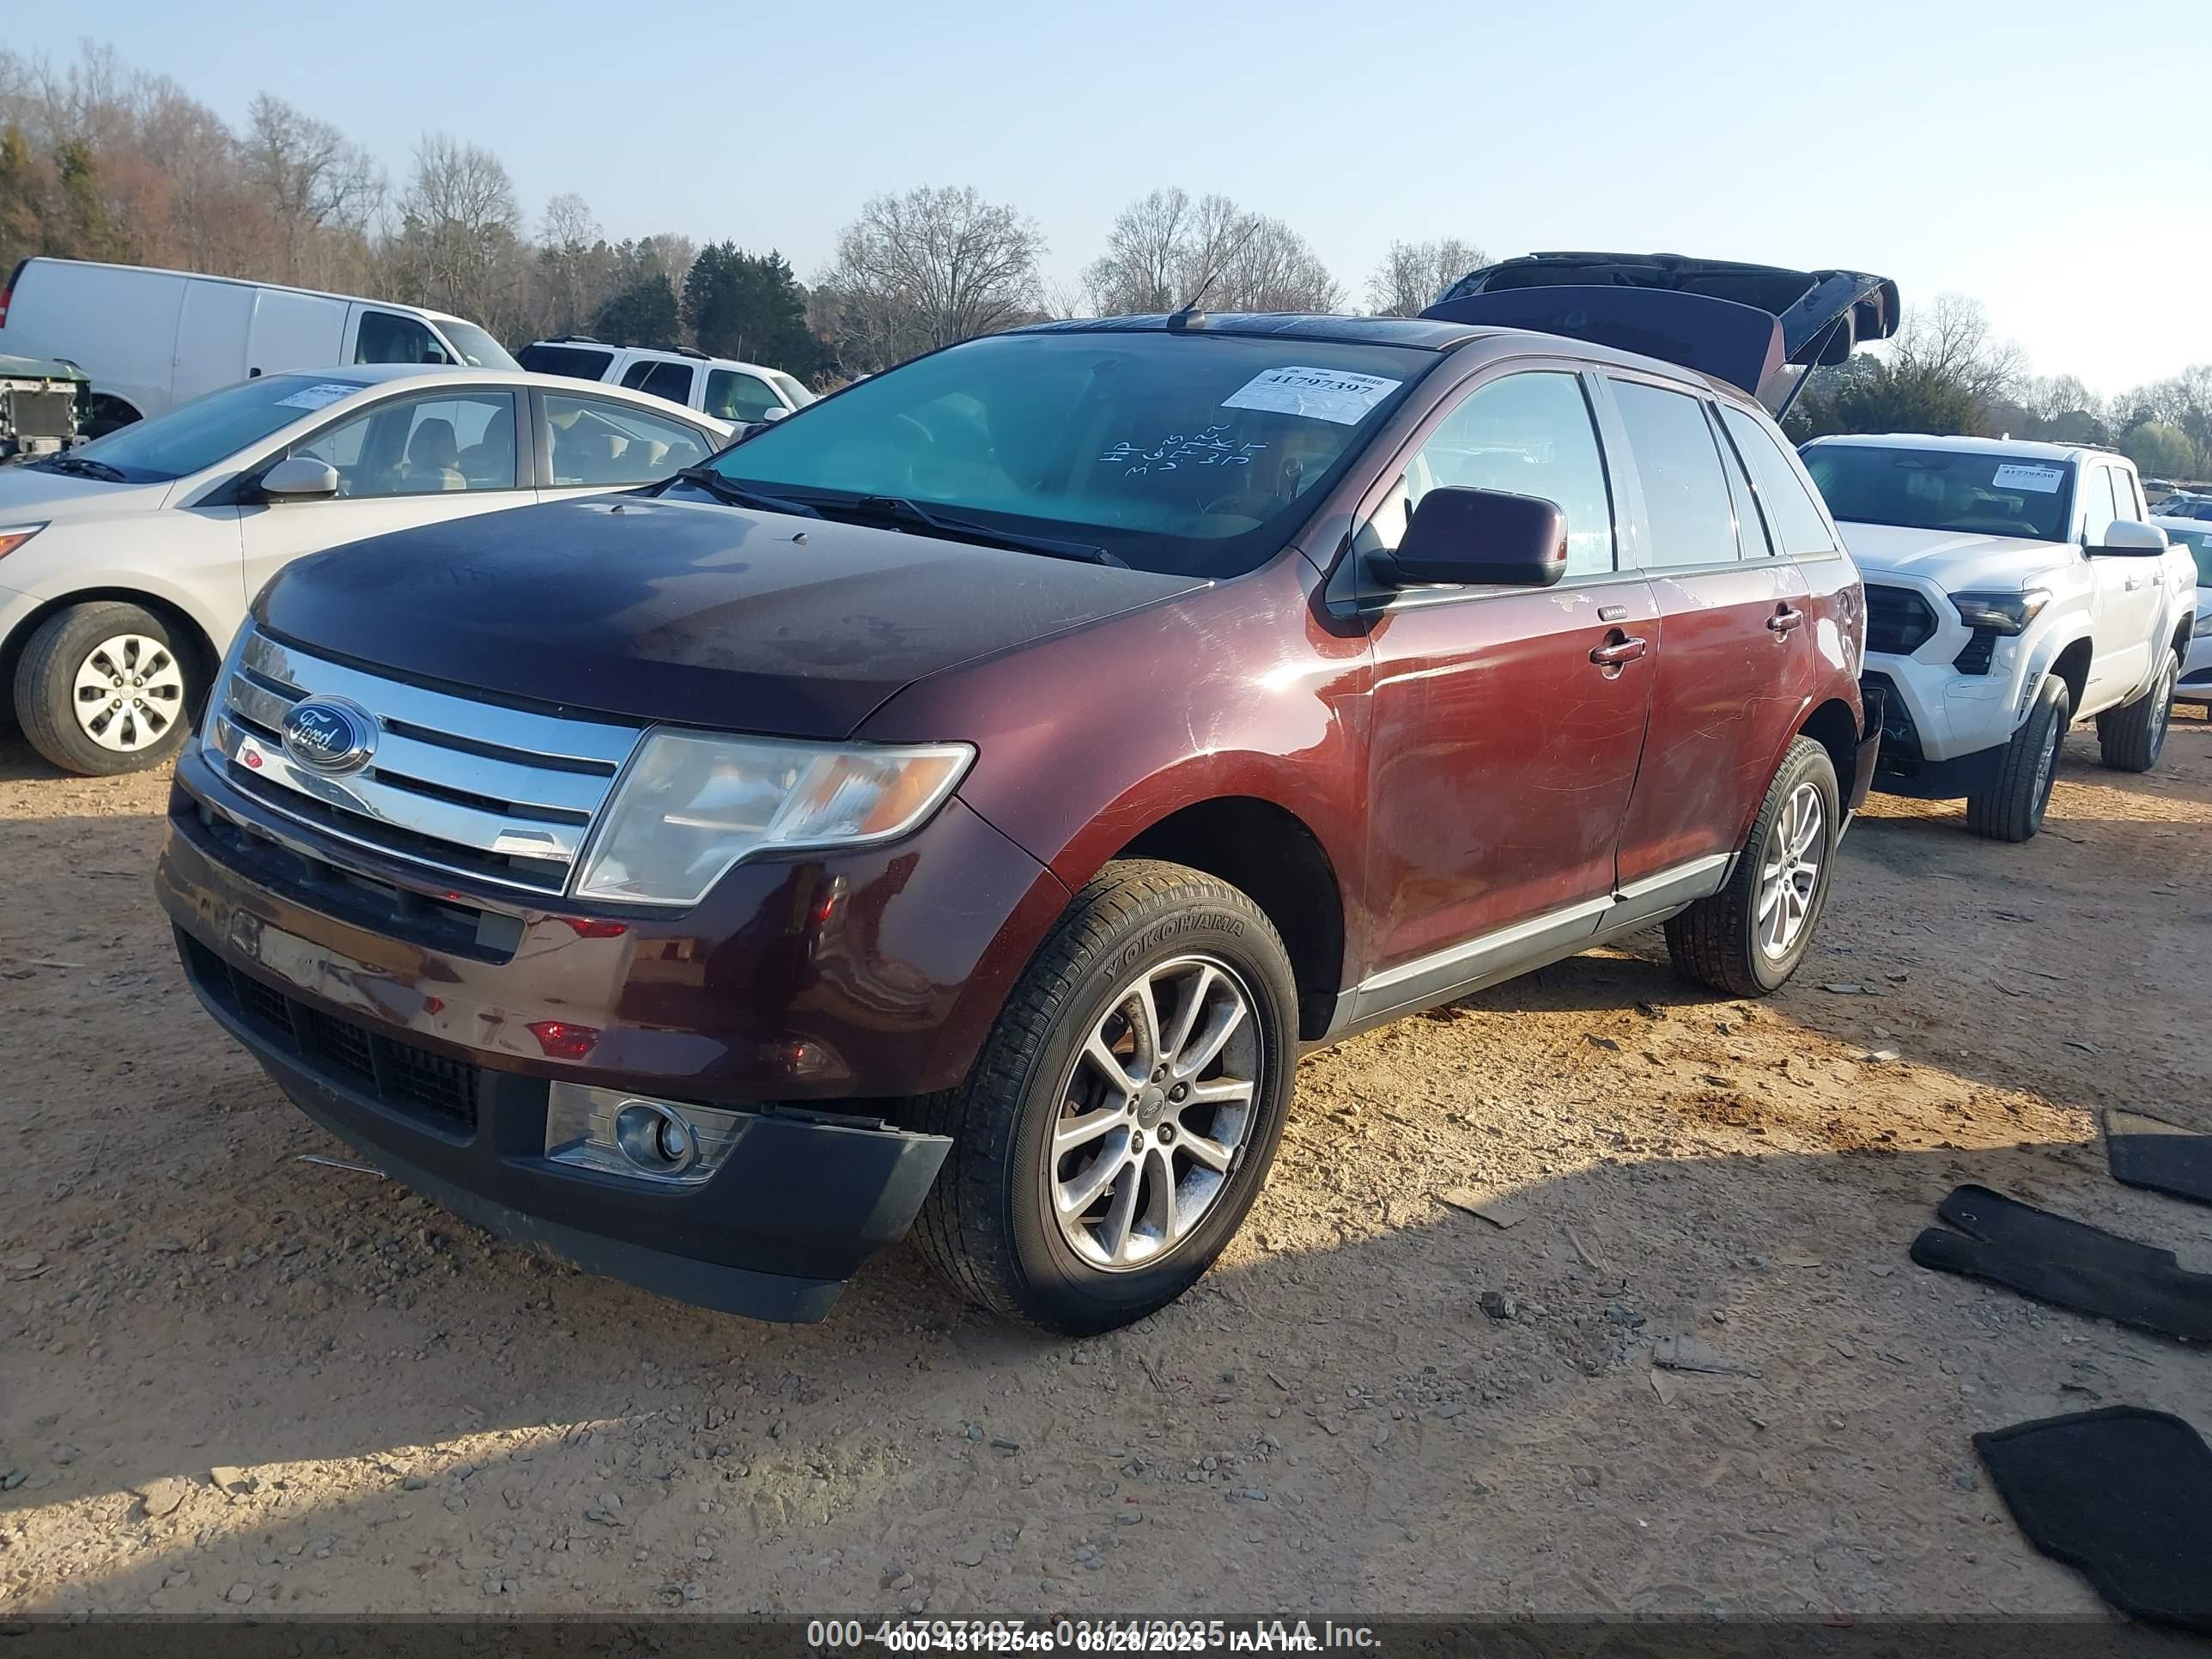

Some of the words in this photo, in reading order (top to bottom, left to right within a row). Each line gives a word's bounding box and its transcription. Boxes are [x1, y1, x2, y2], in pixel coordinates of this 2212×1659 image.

[1267, 374, 1376, 396] 41797397
[289, 709, 339, 751] Ford
[1104, 912, 1246, 981] YOKOHAMA
